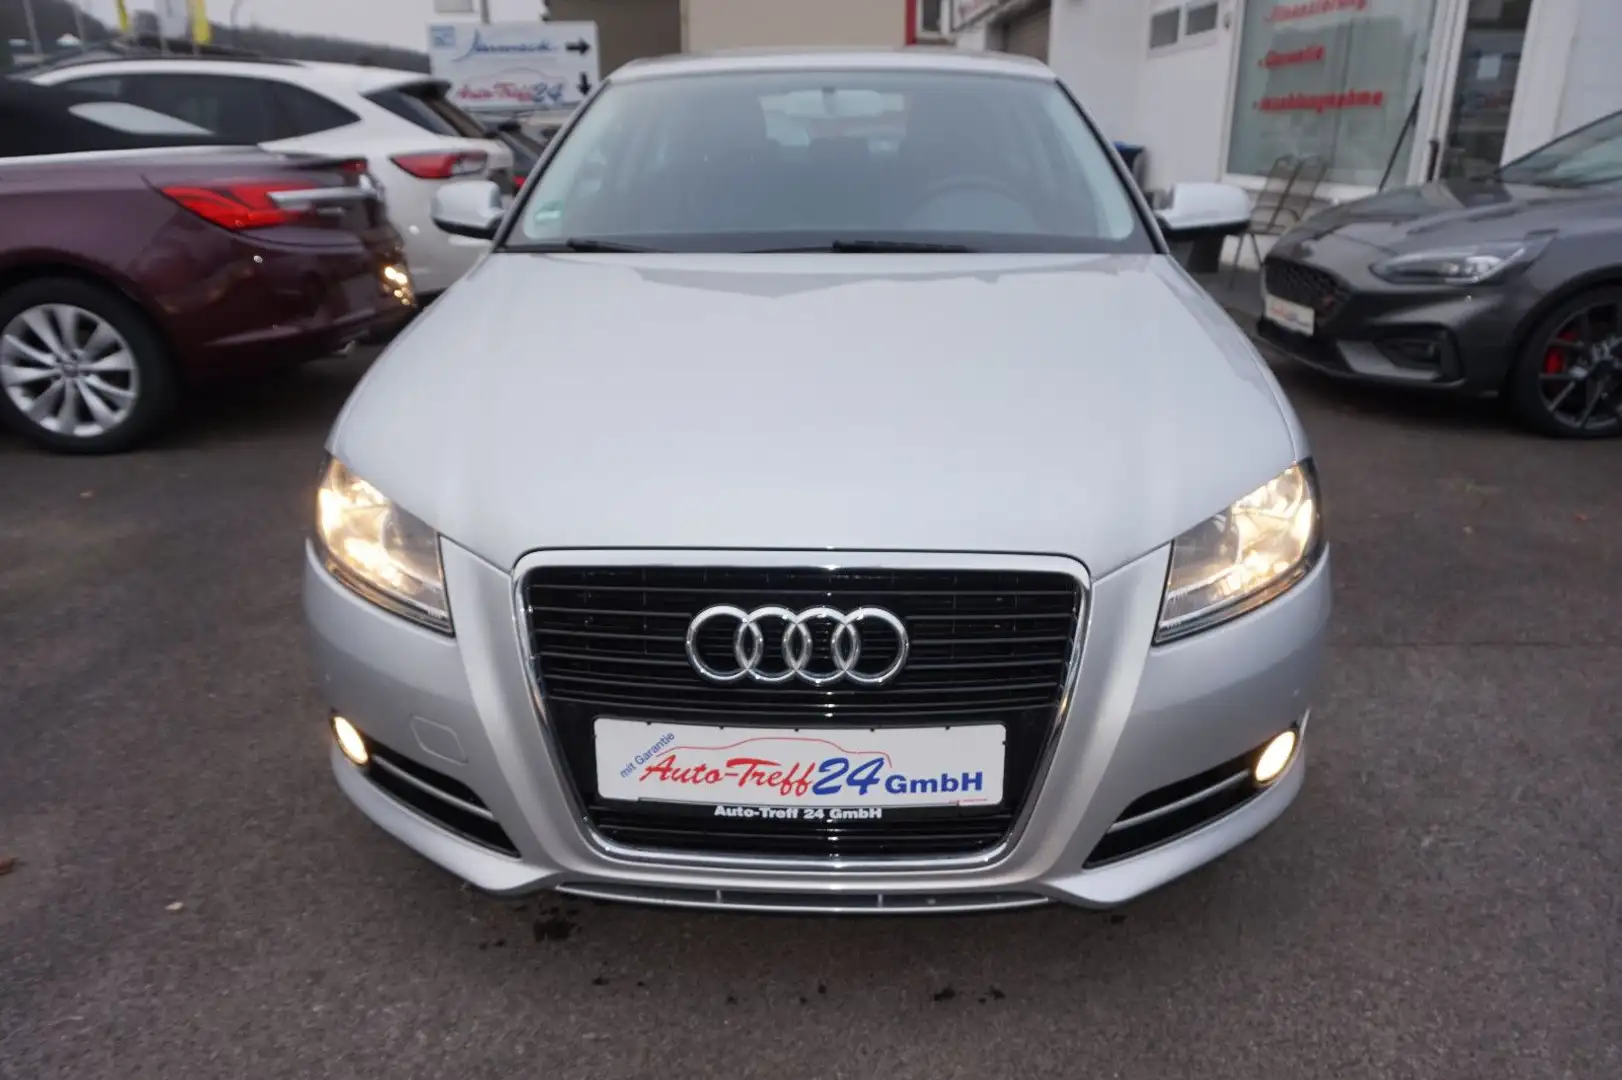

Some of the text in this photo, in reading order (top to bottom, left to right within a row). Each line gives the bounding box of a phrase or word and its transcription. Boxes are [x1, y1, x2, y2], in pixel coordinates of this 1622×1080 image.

[620, 732, 675, 778] mit Garantie
[885, 772, 983, 794] GmbH
[714, 805, 882, 819] Auto-Treff 24 GmbH
